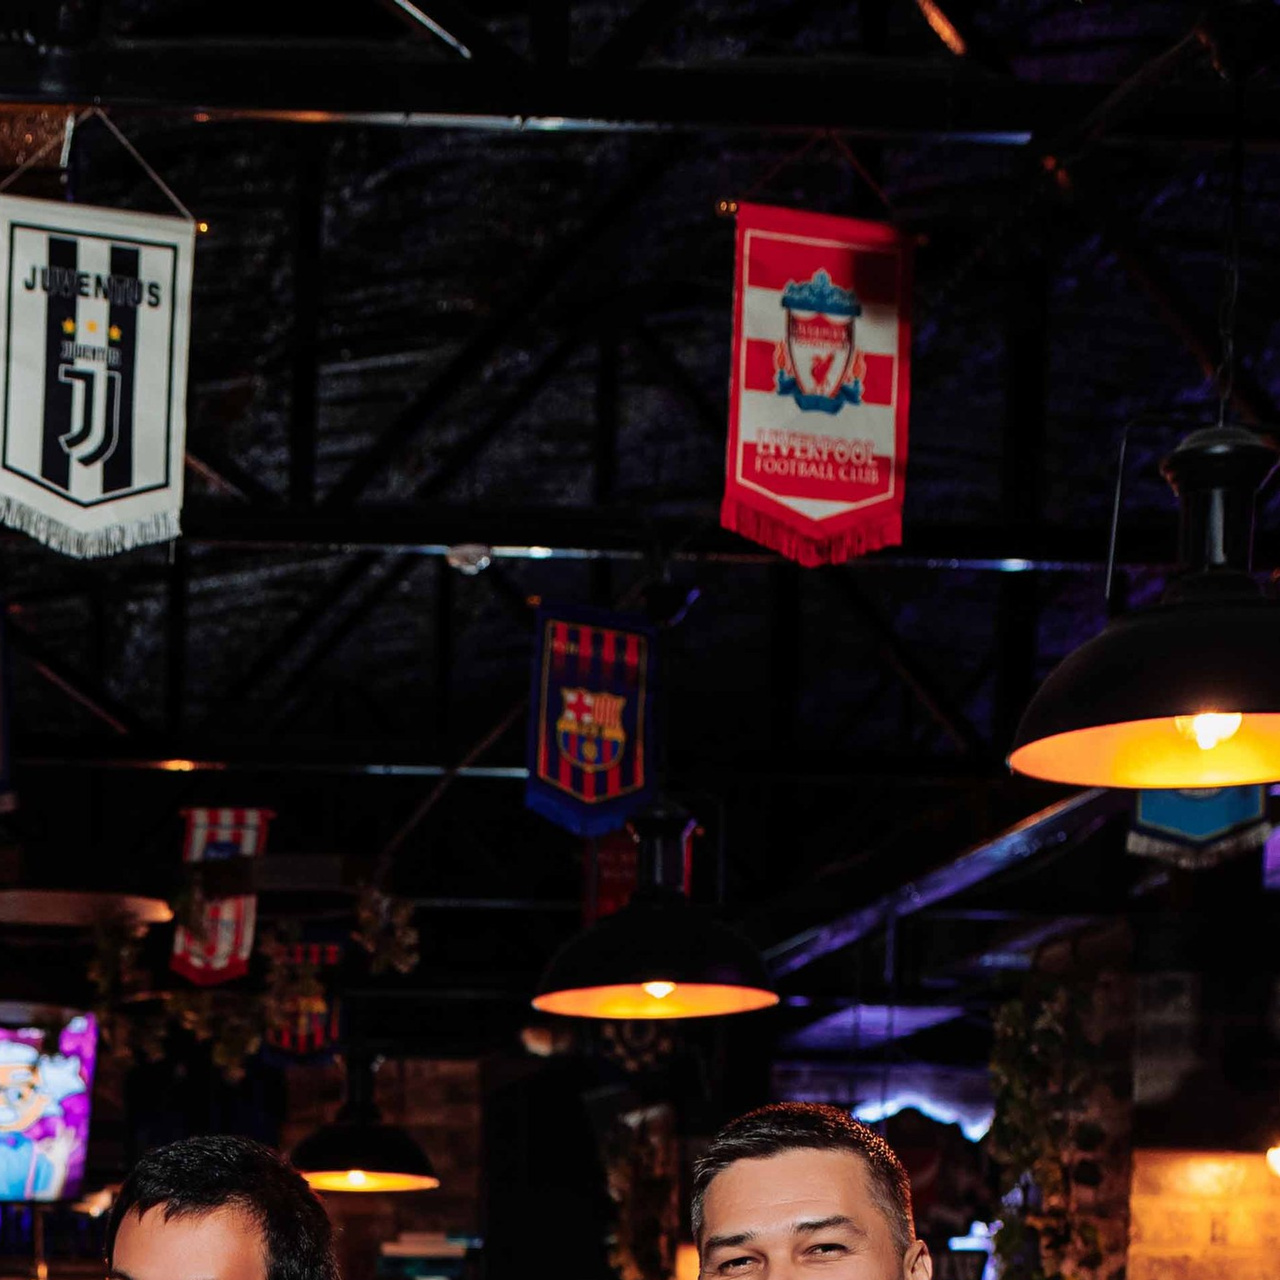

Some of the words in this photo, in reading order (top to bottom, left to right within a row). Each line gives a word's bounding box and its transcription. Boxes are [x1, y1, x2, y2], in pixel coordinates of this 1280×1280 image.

[24, 265, 161, 308] JUVENTUS
[756, 427, 877, 466] LIVERPOOL
[754, 455, 836, 481] FOOTBALL
[837, 465, 879, 485] CLUB
